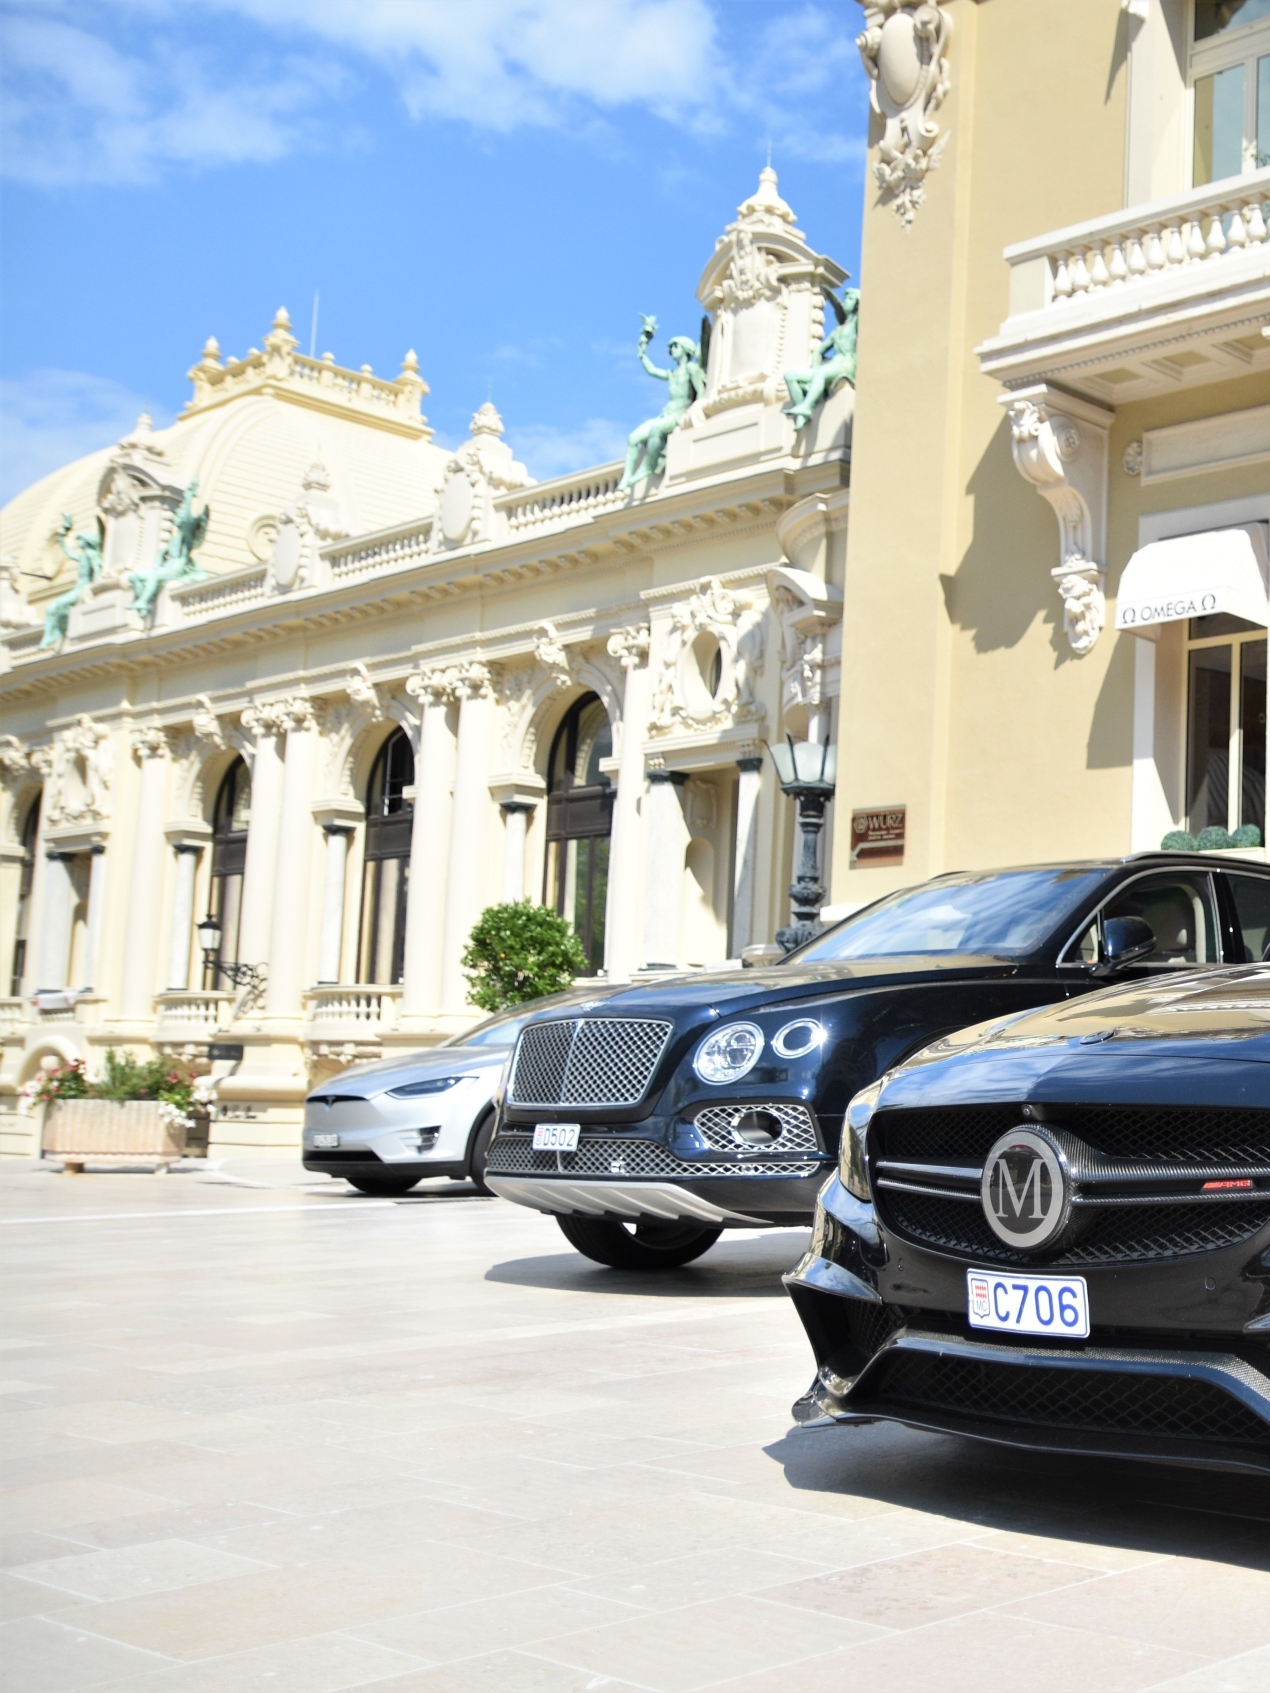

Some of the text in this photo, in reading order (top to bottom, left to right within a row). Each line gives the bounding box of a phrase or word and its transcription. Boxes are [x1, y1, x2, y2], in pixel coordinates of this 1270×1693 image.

[1140, 600, 1197, 621] OMEGA
[543, 1128, 575, 1147] D502
[994, 1158, 1046, 1219] M
[976, 1300, 988, 1312] MC
[993, 1281, 1080, 1328] C706
